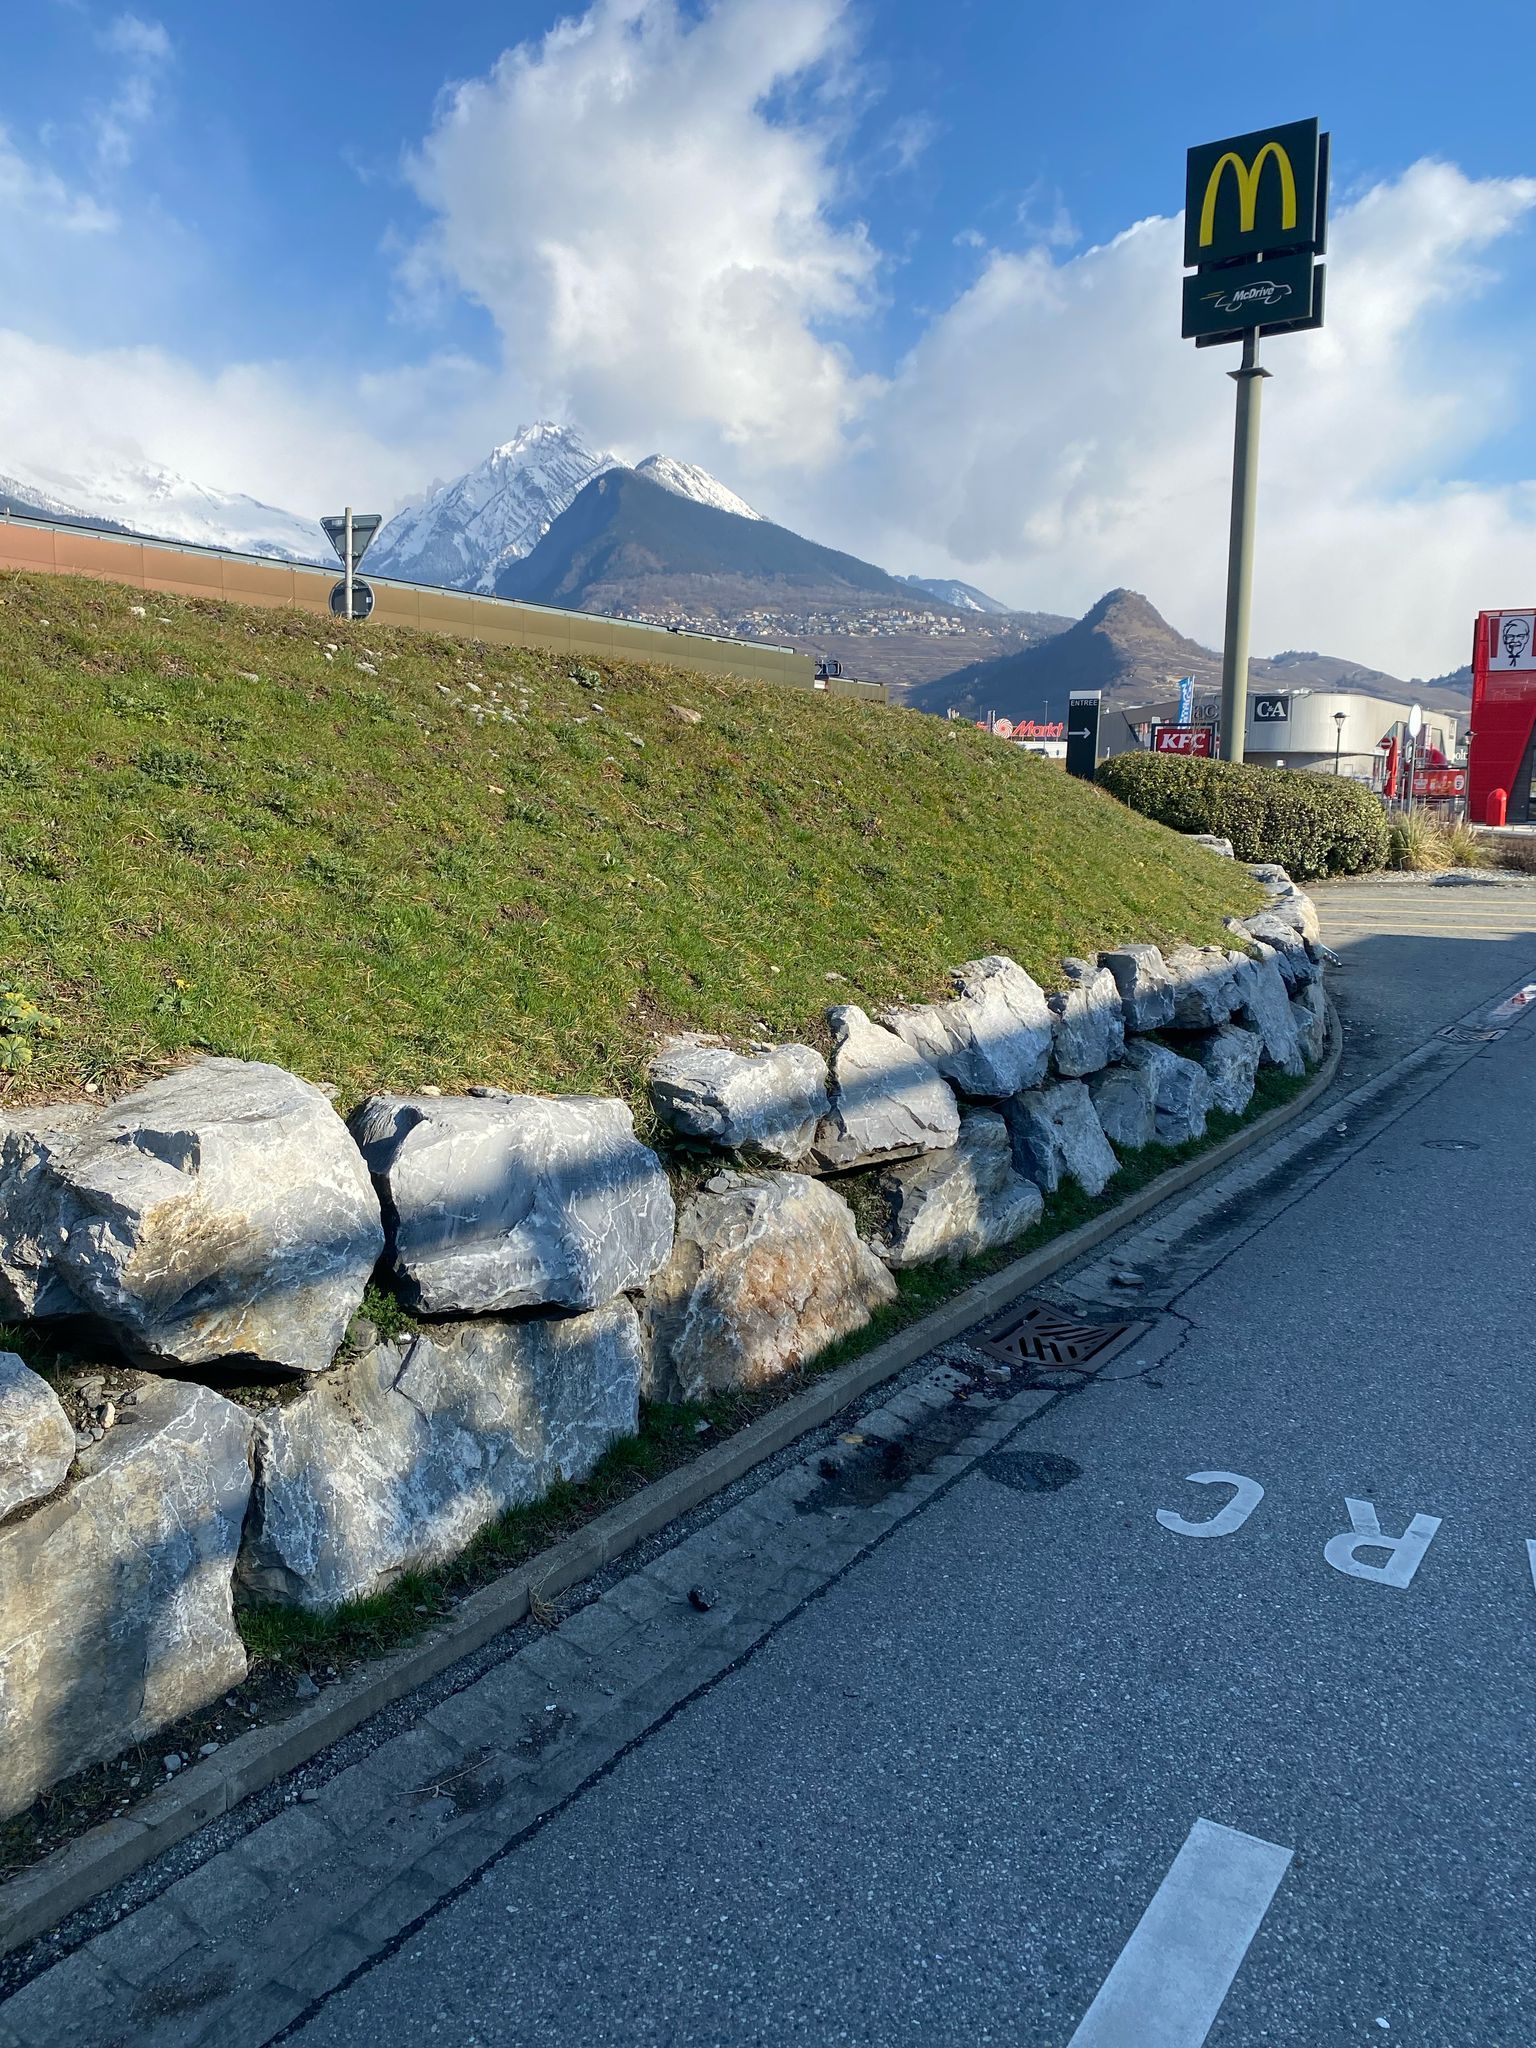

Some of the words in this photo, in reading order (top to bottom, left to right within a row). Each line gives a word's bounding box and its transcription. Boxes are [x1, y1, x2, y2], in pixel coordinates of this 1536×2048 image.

[1232, 286, 1275, 302] McDrive
[1070, 699, 1098, 707] ENTREE
[1257, 701, 1286, 718] C&A
[1010, 720, 1064, 737] Markt
[1160, 733, 1206, 749] KFC
